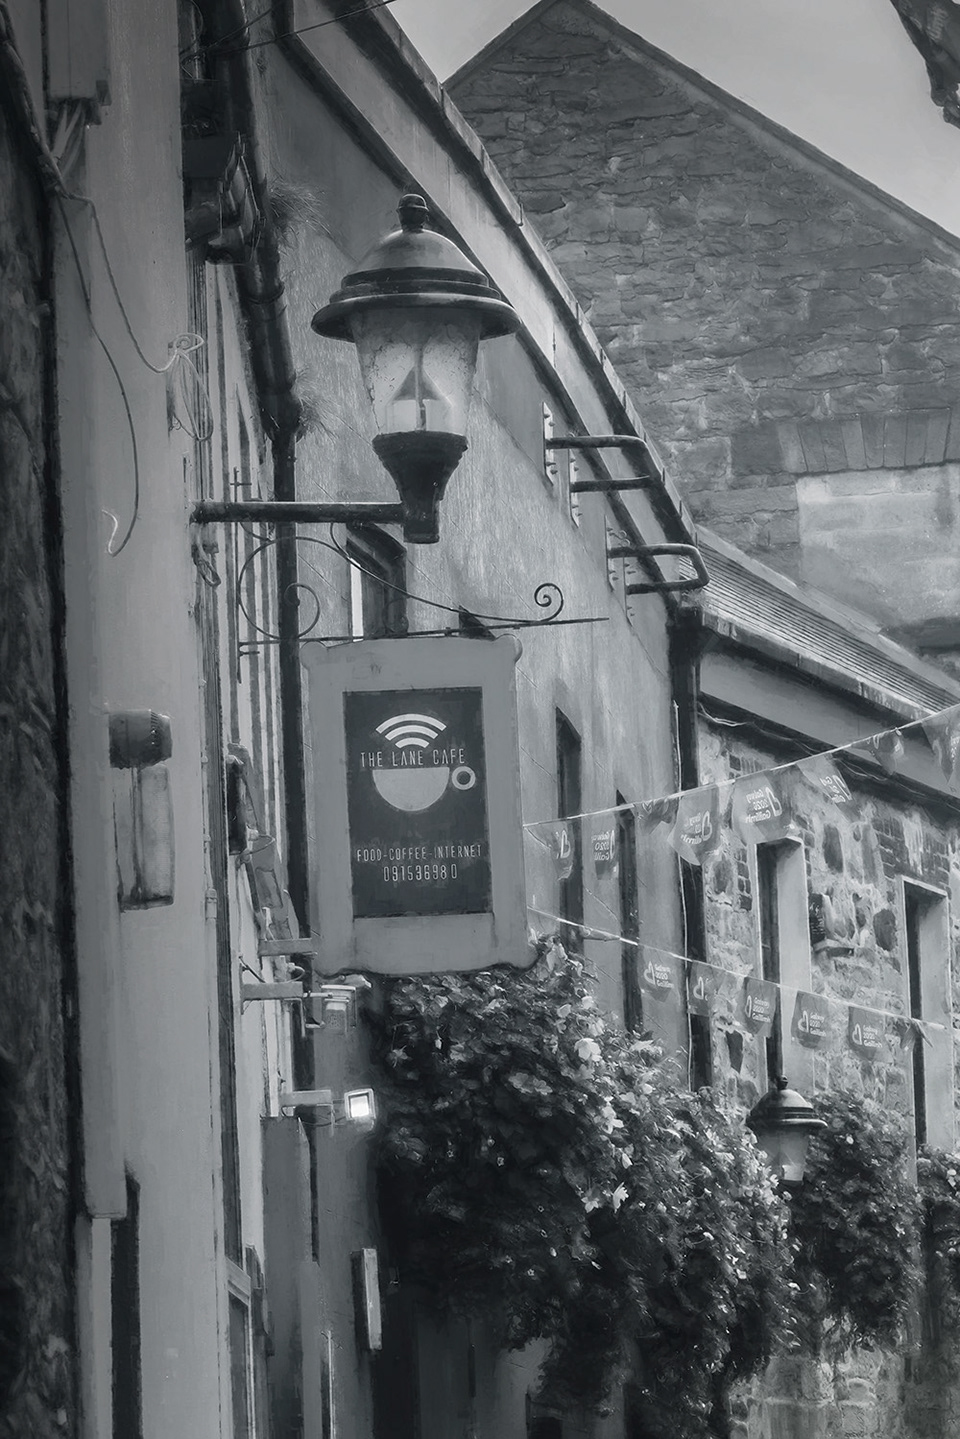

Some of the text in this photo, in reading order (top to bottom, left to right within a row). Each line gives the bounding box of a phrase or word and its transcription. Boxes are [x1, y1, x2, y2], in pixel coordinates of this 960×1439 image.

[360, 748, 466, 767] THE LANE CAFE
[382, 863, 457, 881] 091536980
